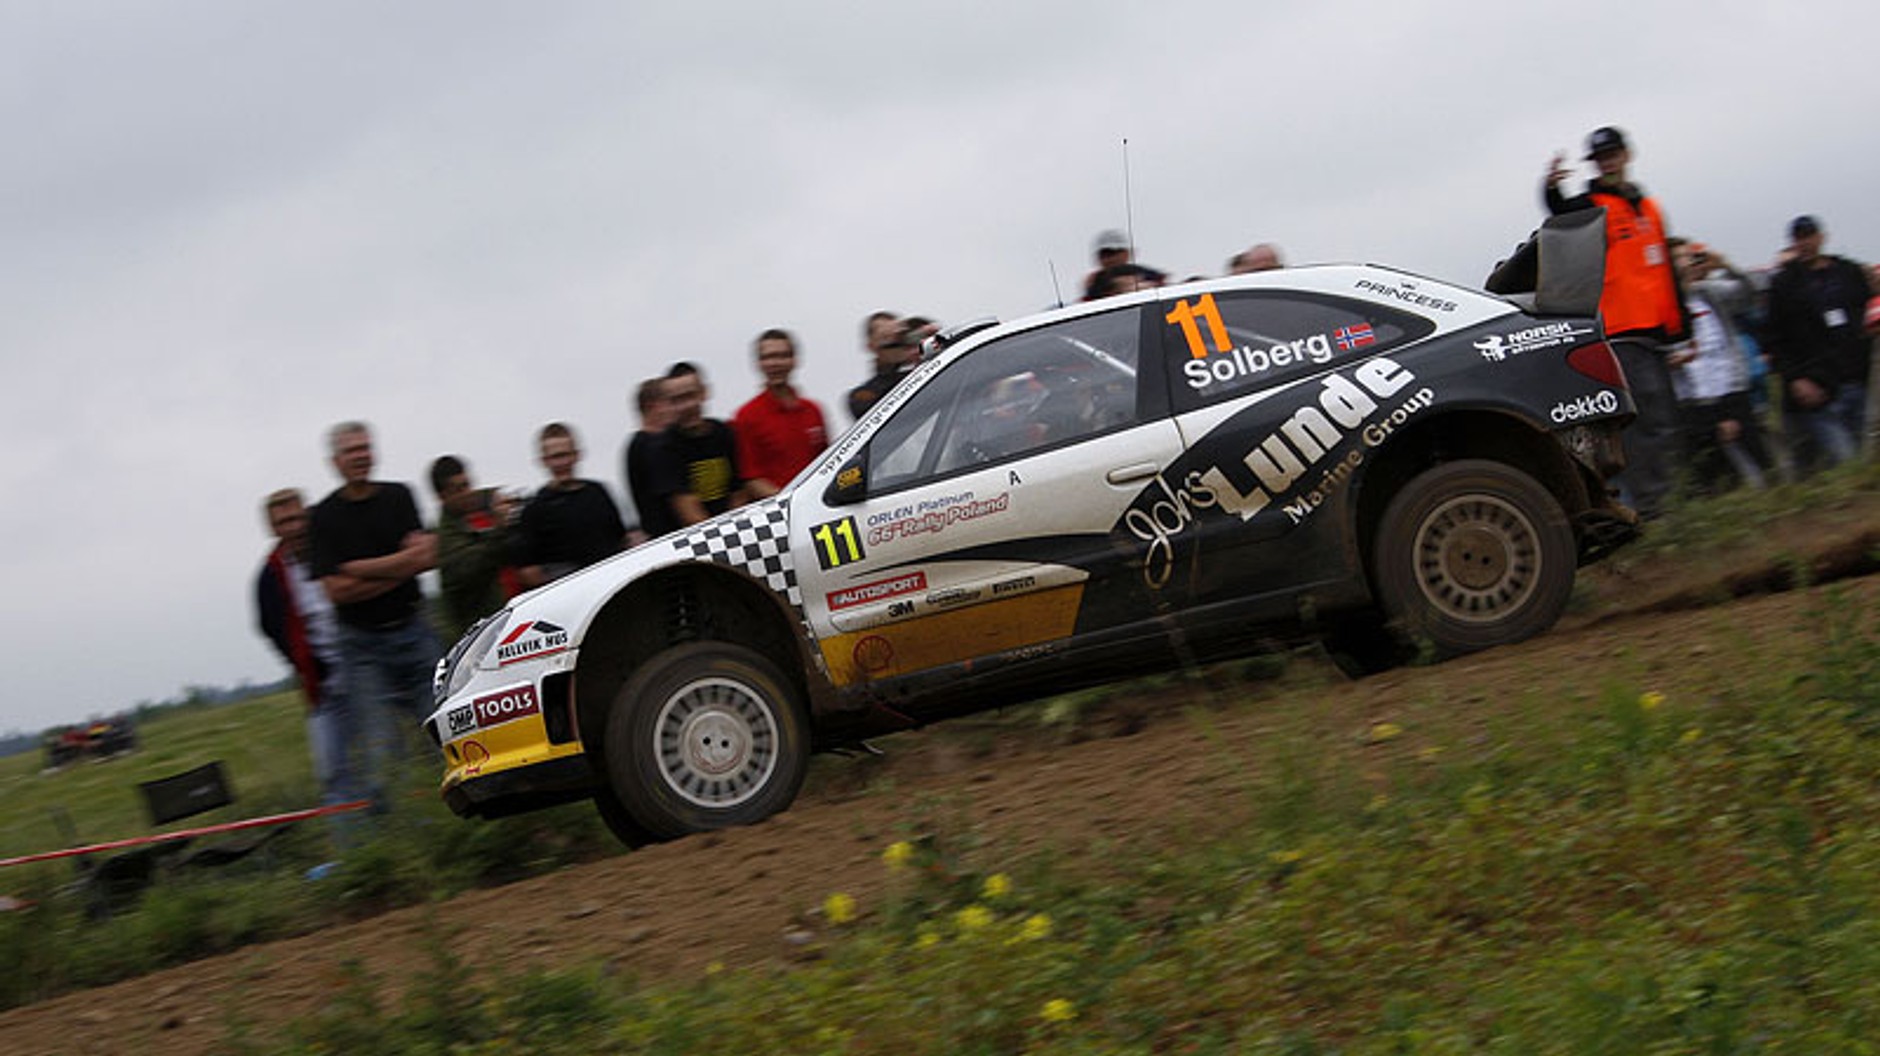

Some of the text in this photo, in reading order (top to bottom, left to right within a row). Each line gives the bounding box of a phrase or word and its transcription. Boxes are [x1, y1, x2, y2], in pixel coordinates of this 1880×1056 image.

[1354, 280, 1458, 313] PRINCESS
[1165, 293, 1233, 359] 11
[1508, 322, 1572, 344] NORSK
[1184, 332, 1332, 388] Solberg
[1200, 355, 1415, 522] Lunde
[1282, 386, 1435, 525] Marine Group
[1009, 470, 1022, 487] A
[867, 491, 973, 527] ORLEN Platinum
[902, 512, 947, 538] Rally
[947, 492, 1009, 528] Poland
[815, 519, 860, 567] 11
[888, 600, 916, 618] 3M
[498, 632, 568, 660] HELLVIK HUS
[477, 691, 534, 719] TOOLS
